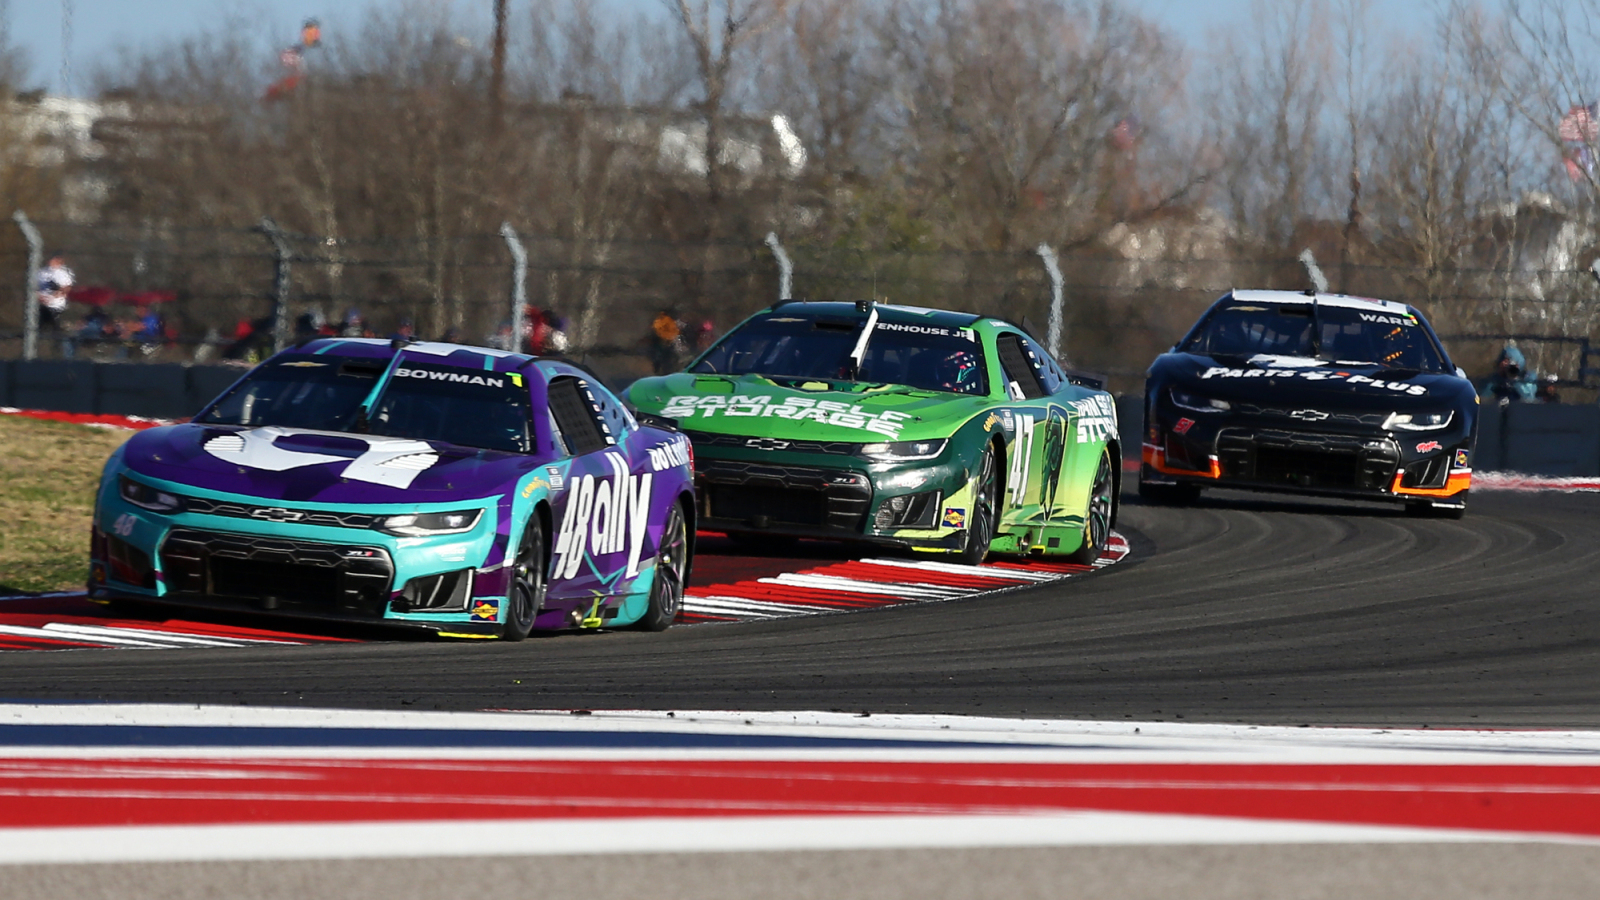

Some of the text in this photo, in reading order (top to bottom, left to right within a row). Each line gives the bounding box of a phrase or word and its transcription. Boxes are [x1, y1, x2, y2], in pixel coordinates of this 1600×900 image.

[1358, 313, 1414, 327] WARE
[393, 367, 504, 388] BOWMAN
[1201, 366, 1428, 396] PARTS PLUS
[659, 404, 906, 441] STORAGE
[665, 395, 912, 422] RAM SELF
[1173, 417, 1195, 434] 51
[1008, 413, 1034, 507] 47
[112, 513, 137, 537] 48
[552, 473, 595, 580] 48
[591, 451, 653, 580] ally
